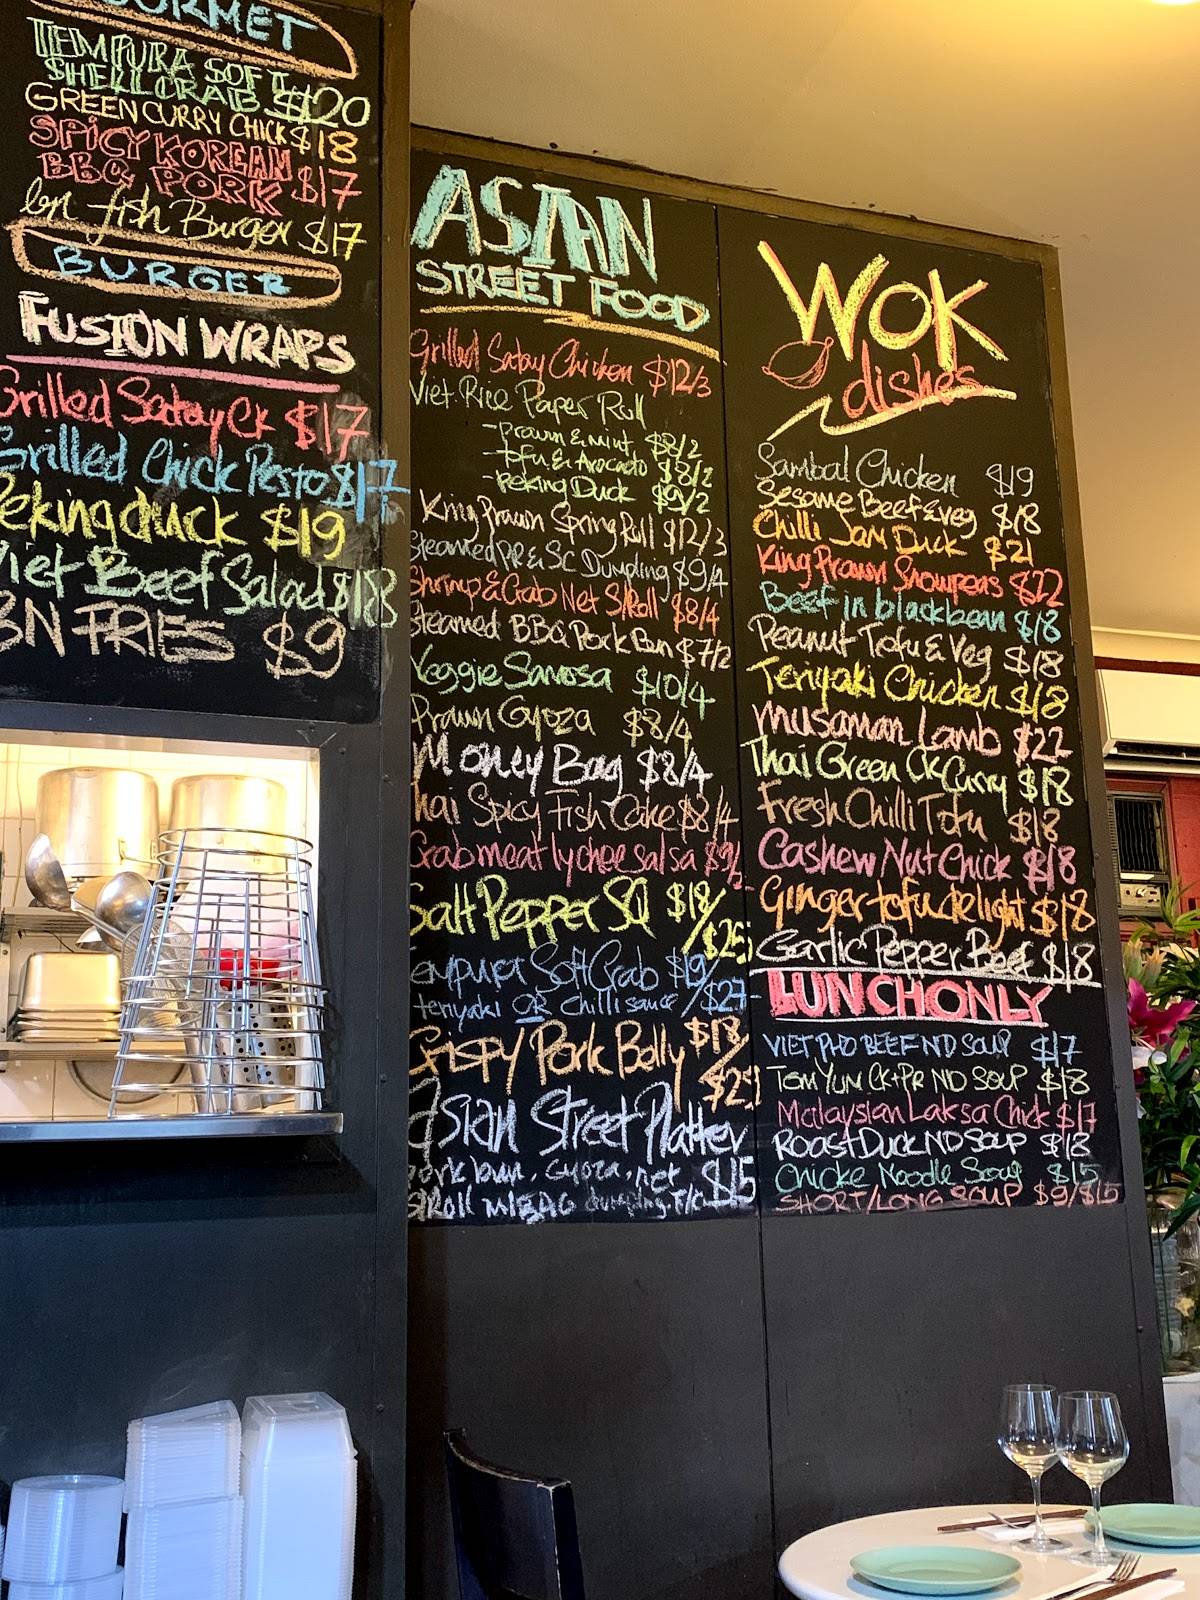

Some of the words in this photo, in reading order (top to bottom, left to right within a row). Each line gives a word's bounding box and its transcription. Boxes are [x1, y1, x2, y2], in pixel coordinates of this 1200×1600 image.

[25, 82, 138, 123] GREEN
[150, 166, 283, 216] PORK
[298, 216, 366, 260] $17
[410, 164, 658, 285] ASIAN
[53, 245, 293, 295] BURGER
[416, 258, 576, 307] STREET
[757, 240, 1009, 373] WOK
[843, 340, 983, 419] dishes
[985, 463, 1034, 498] $19
[261, 502, 347, 560] $19
[263, 611, 347, 680] $9
